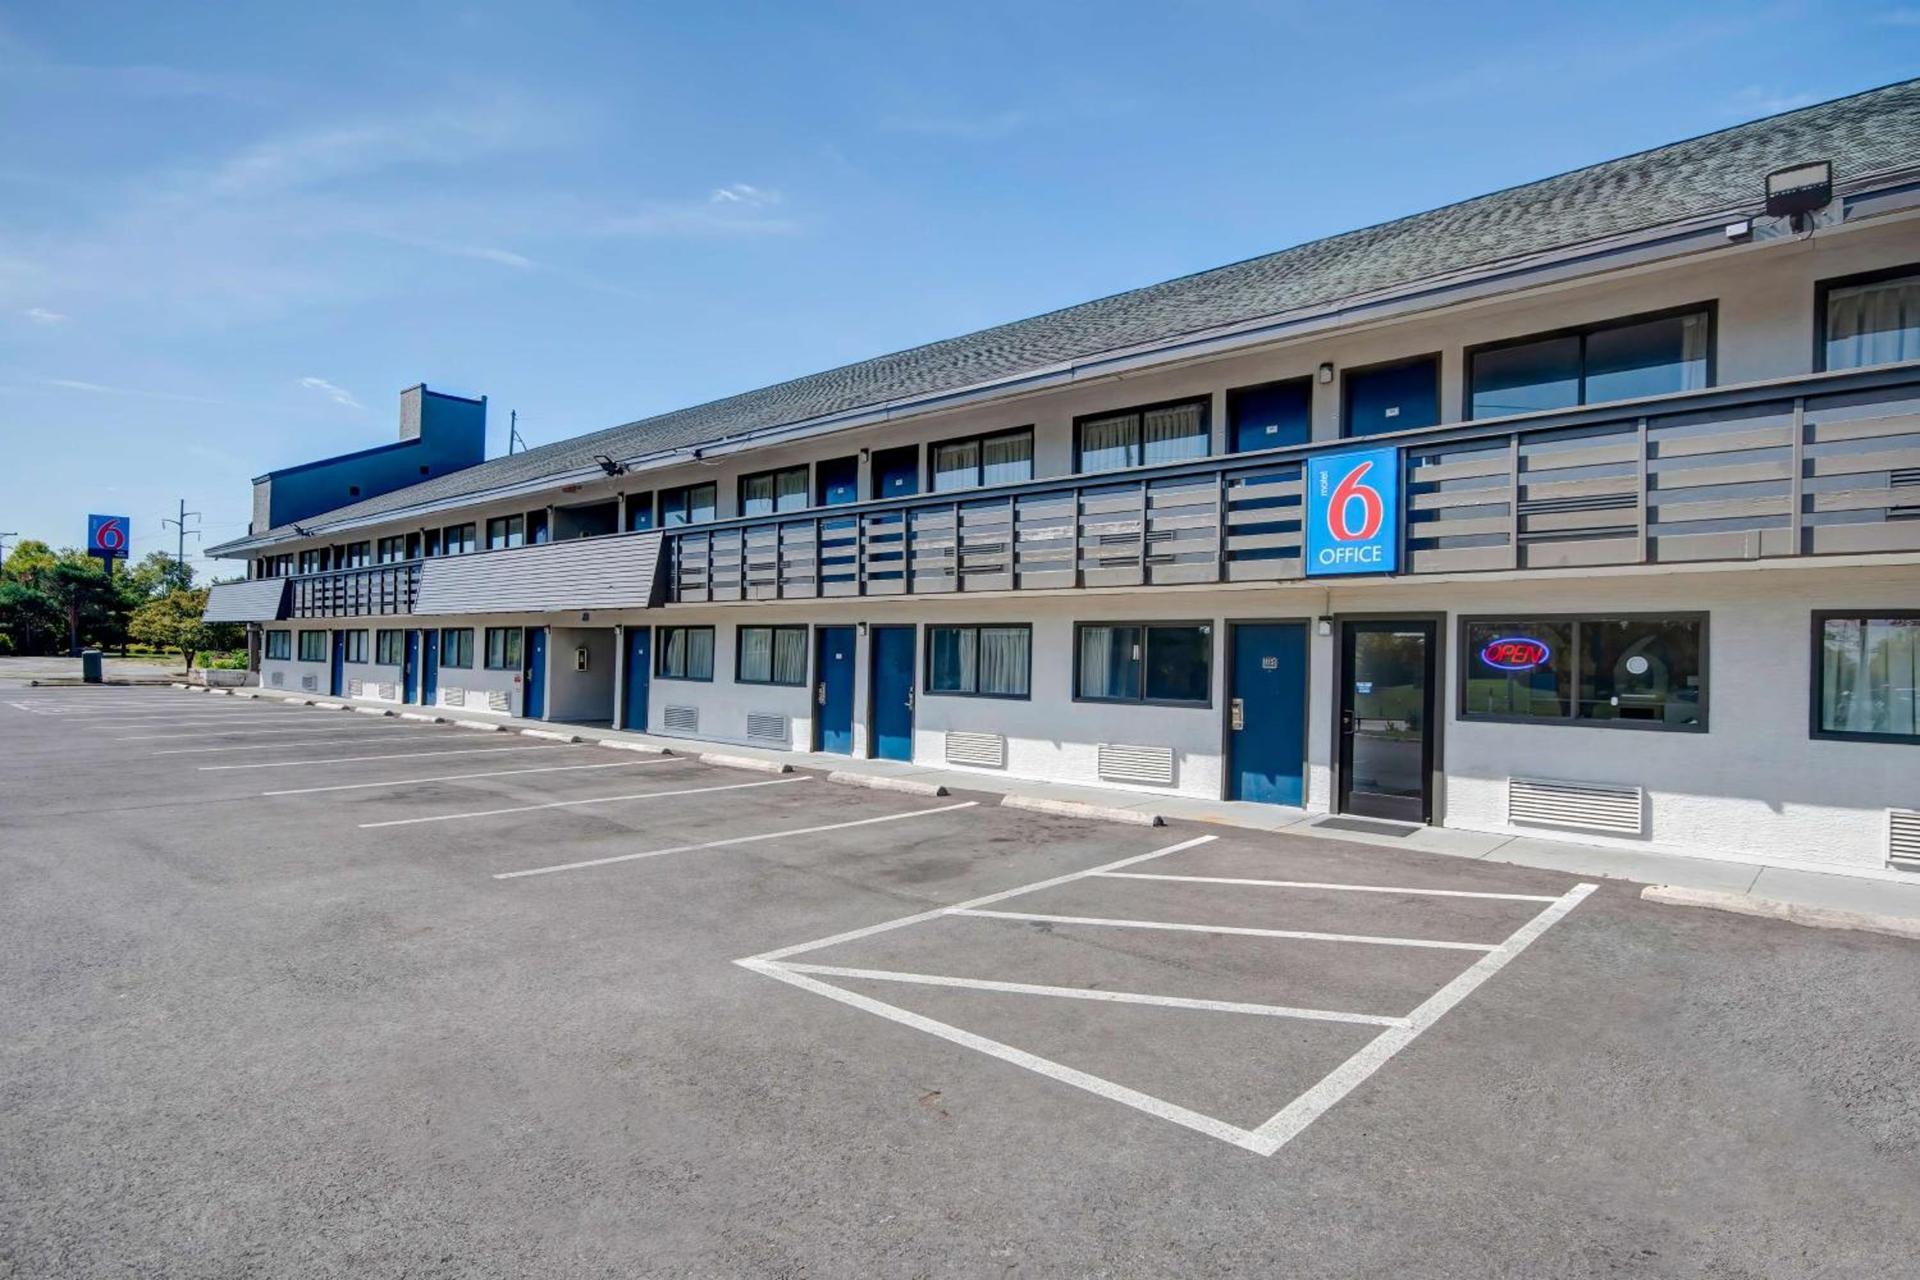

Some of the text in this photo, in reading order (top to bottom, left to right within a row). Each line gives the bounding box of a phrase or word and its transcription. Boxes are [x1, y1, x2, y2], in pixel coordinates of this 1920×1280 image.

[1327, 460, 1384, 541] 6
[96, 519, 125, 550] 6
[1319, 545, 1382, 565] OFFICE
[1486, 643, 1543, 664] OPEN
